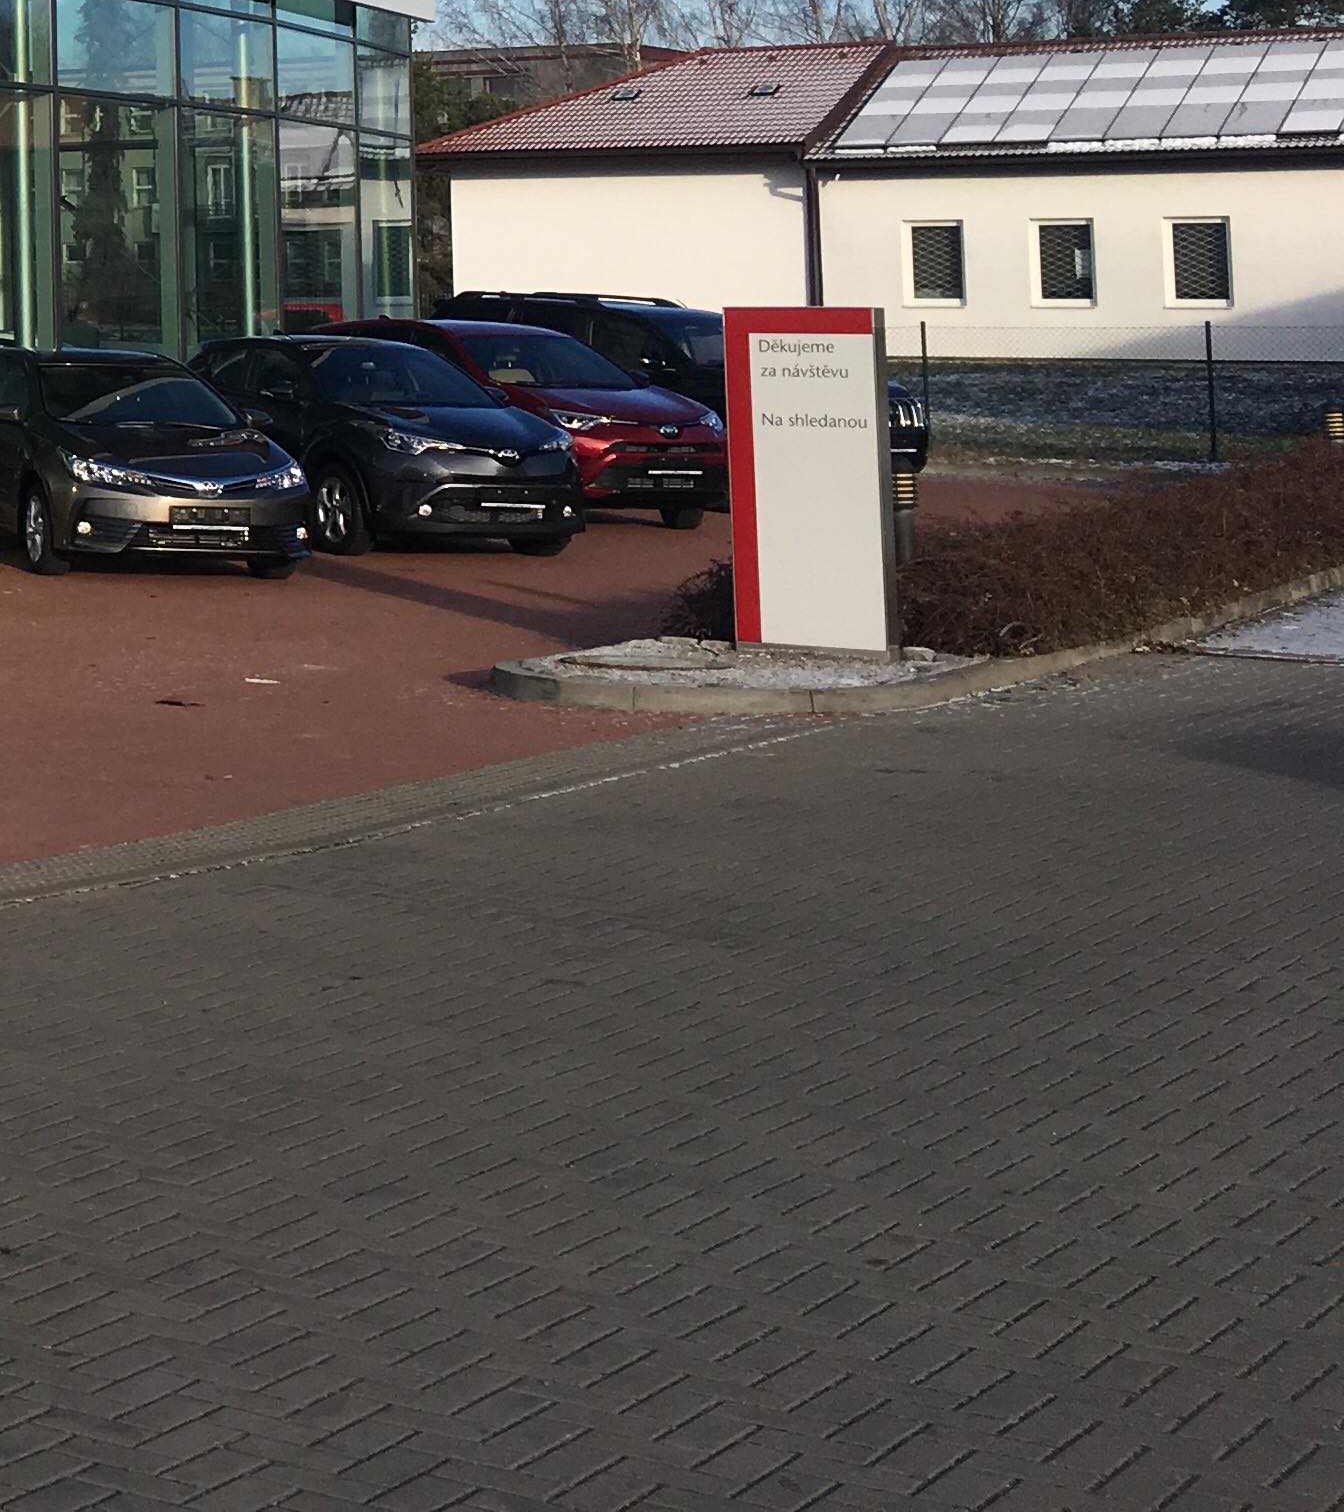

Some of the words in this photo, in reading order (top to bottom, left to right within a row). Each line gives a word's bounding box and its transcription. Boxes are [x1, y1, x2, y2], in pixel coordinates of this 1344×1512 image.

[758, 338, 835, 356] Děkujeme
[760, 366, 777, 377] za
[782, 363, 849, 378] návštěvu
[761, 412, 783, 426] Na
[788, 413, 868, 429] shledanou
